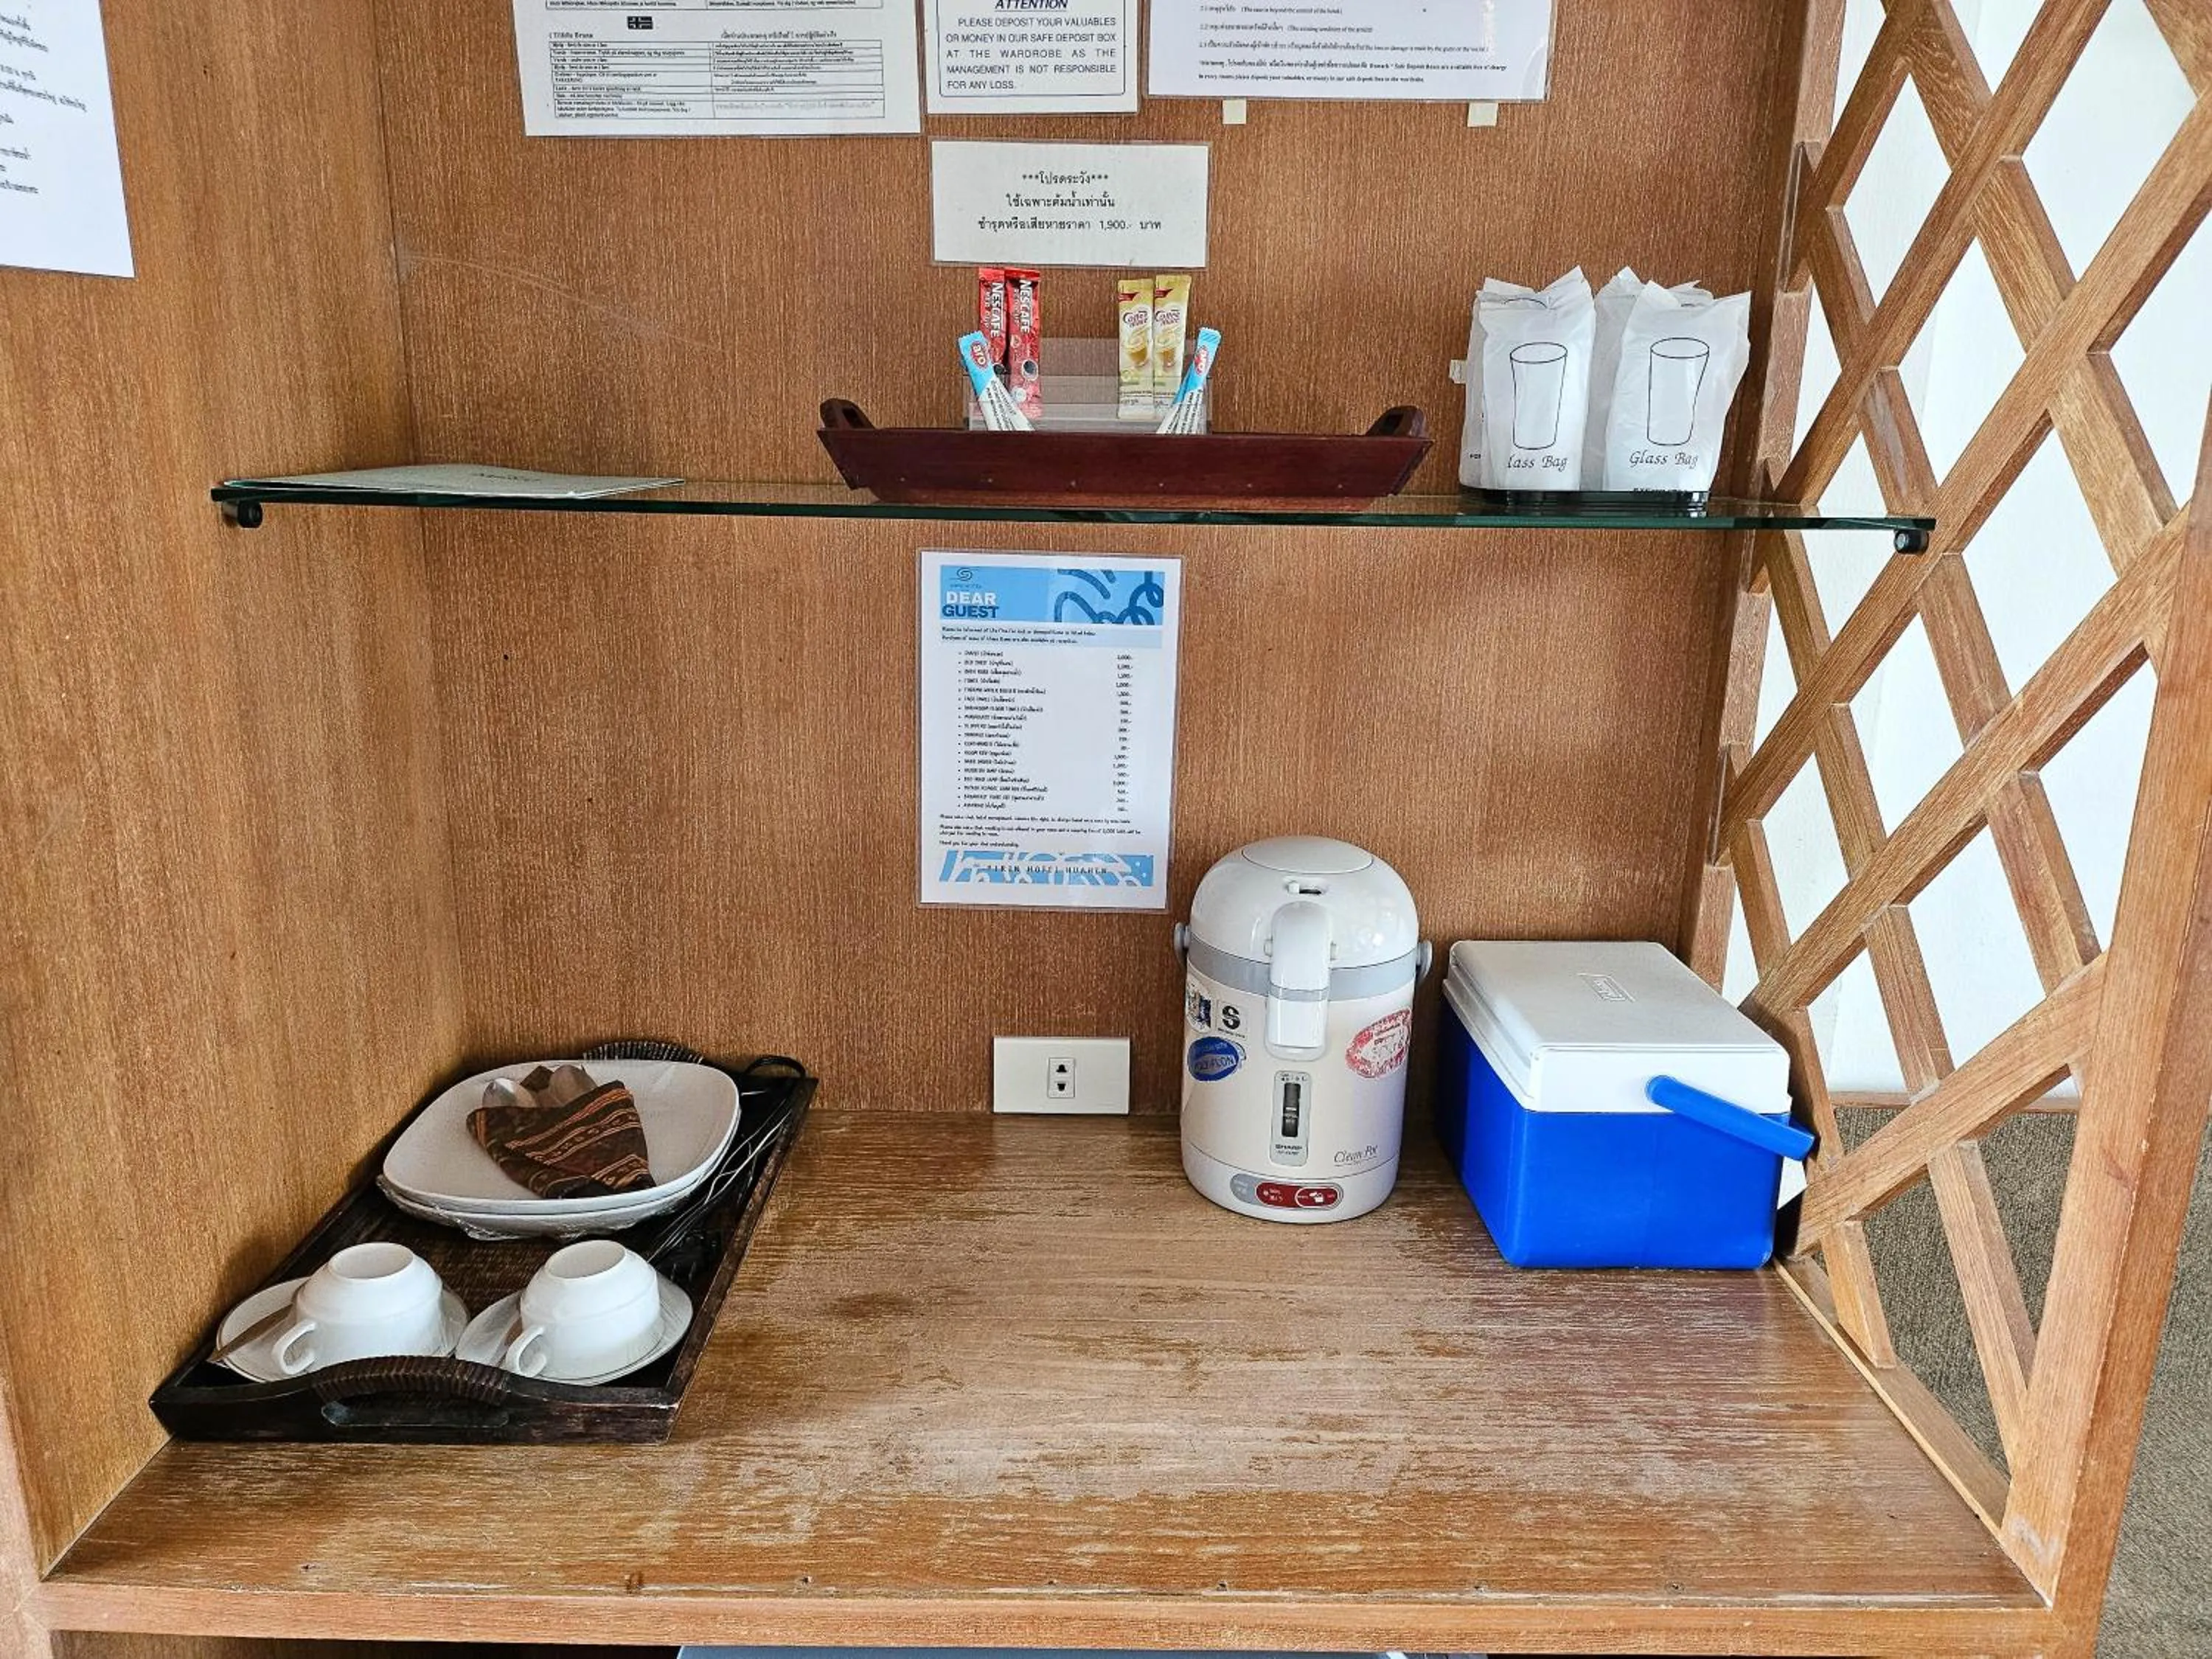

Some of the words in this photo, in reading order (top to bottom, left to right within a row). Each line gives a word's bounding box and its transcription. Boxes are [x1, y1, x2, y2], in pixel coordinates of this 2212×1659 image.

[995, 0, 1068, 9] ATTENTION
[958, 18, 993, 27] PLEASE
[995, 18, 1034, 27] DEPOSIT
[1037, 18, 1062, 27] YOUR
[1065, 18, 1116, 27] VALUABLES
[946, 34, 959, 43] OR
[961, 34, 994, 43] MONEY
[997, 34, 1006, 43] IN
[1009, 34, 1028, 43] OUR
[1030, 34, 1054, 43] SAFE
[1056, 34, 1094, 43] DEPOSIT
[1097, 34, 1116, 43] BOX
[946, 49, 959, 58] AT
[970, 49, 990, 58] THE
[1000, 49, 1062, 58] WARDROBE
[1071, 49, 1085, 58] AS
[1096, 49, 1116, 58] THE
[947, 65, 1010, 74] MANAGEMENT
[1015, 65, 1024, 74] IS
[1029, 65, 1049, 74] NOT
[1054, 65, 1117, 74] RESPONSIBLE
[947, 80, 966, 89] FOR
[969, 80, 987, 89] ANY
[1006, 190, 1115, 207] ใช้เฉพาะต้มน้ำเท่านั้น
[978, 217, 1091, 232] ชำรุดหรือเสียหายราคา
[1139, 220, 1162, 230] บาท
[1507, 453, 1535, 468] lass
[1542, 455, 1569, 472] Bag
[1630, 450, 1668, 467] Glass
[1674, 452, 1699, 469] Bag
[945, 591, 996, 605] DEAR
[942, 605, 999, 619] GUEST
[1334, 1149, 1363, 1163] Clean
[1364, 1144, 1378, 1157] Pot
